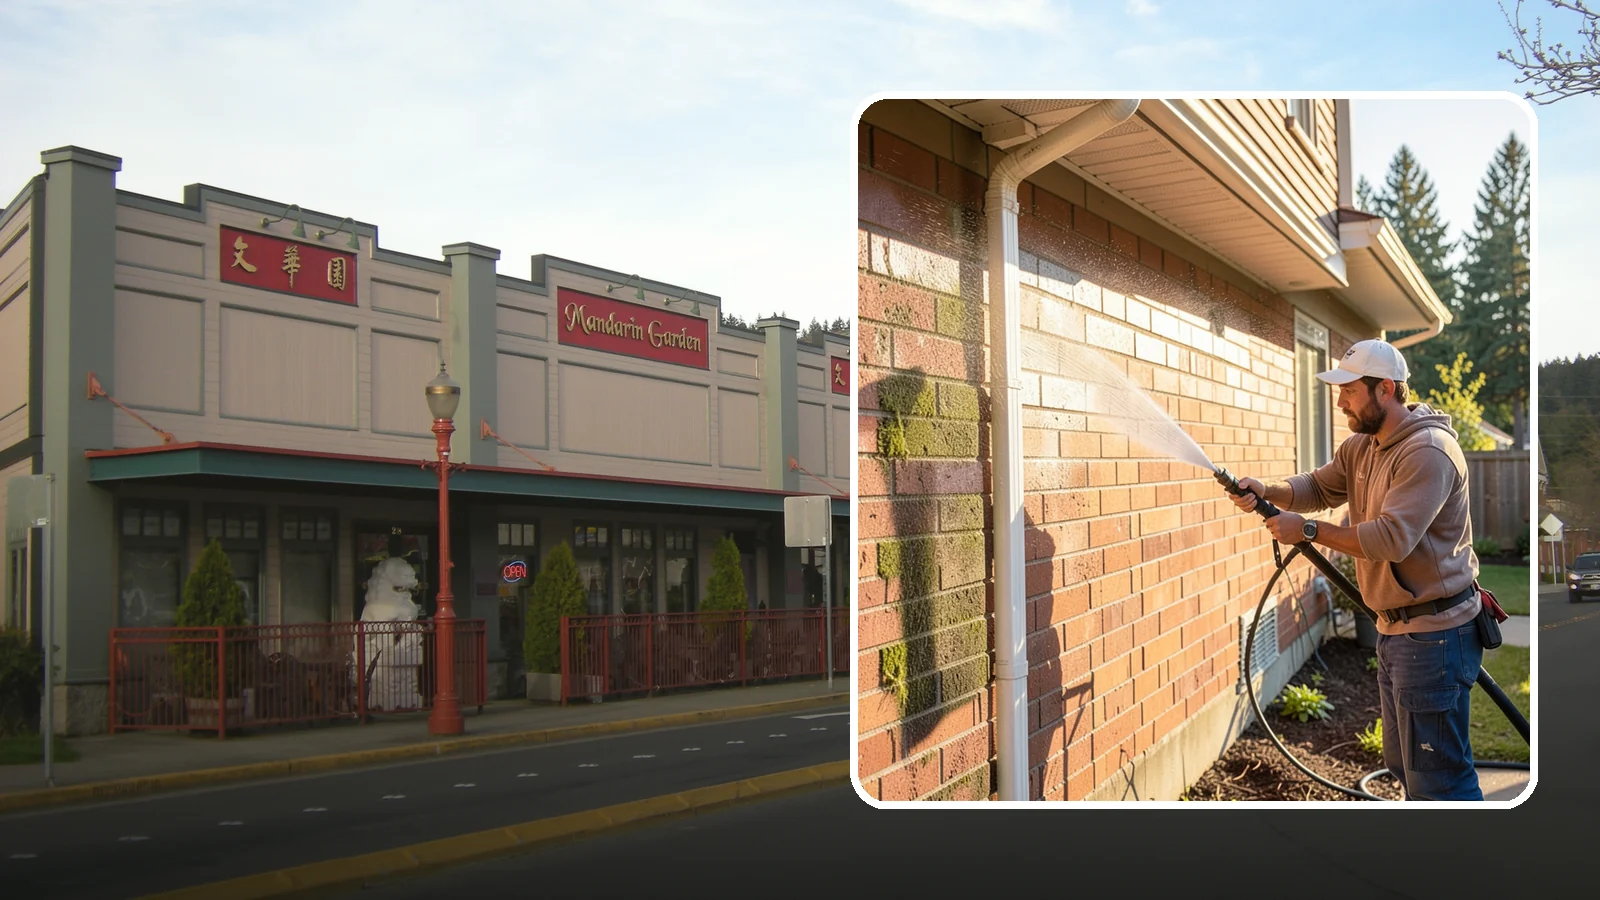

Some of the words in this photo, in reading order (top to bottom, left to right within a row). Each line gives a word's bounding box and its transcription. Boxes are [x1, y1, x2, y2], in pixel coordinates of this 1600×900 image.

[231, 236, 346, 291] 文華園
[564, 302, 644, 341] Mandarin
[648, 320, 702, 352] Garden
[835, 363, 846, 386] 文
[503, 565, 527, 578] OPEN
